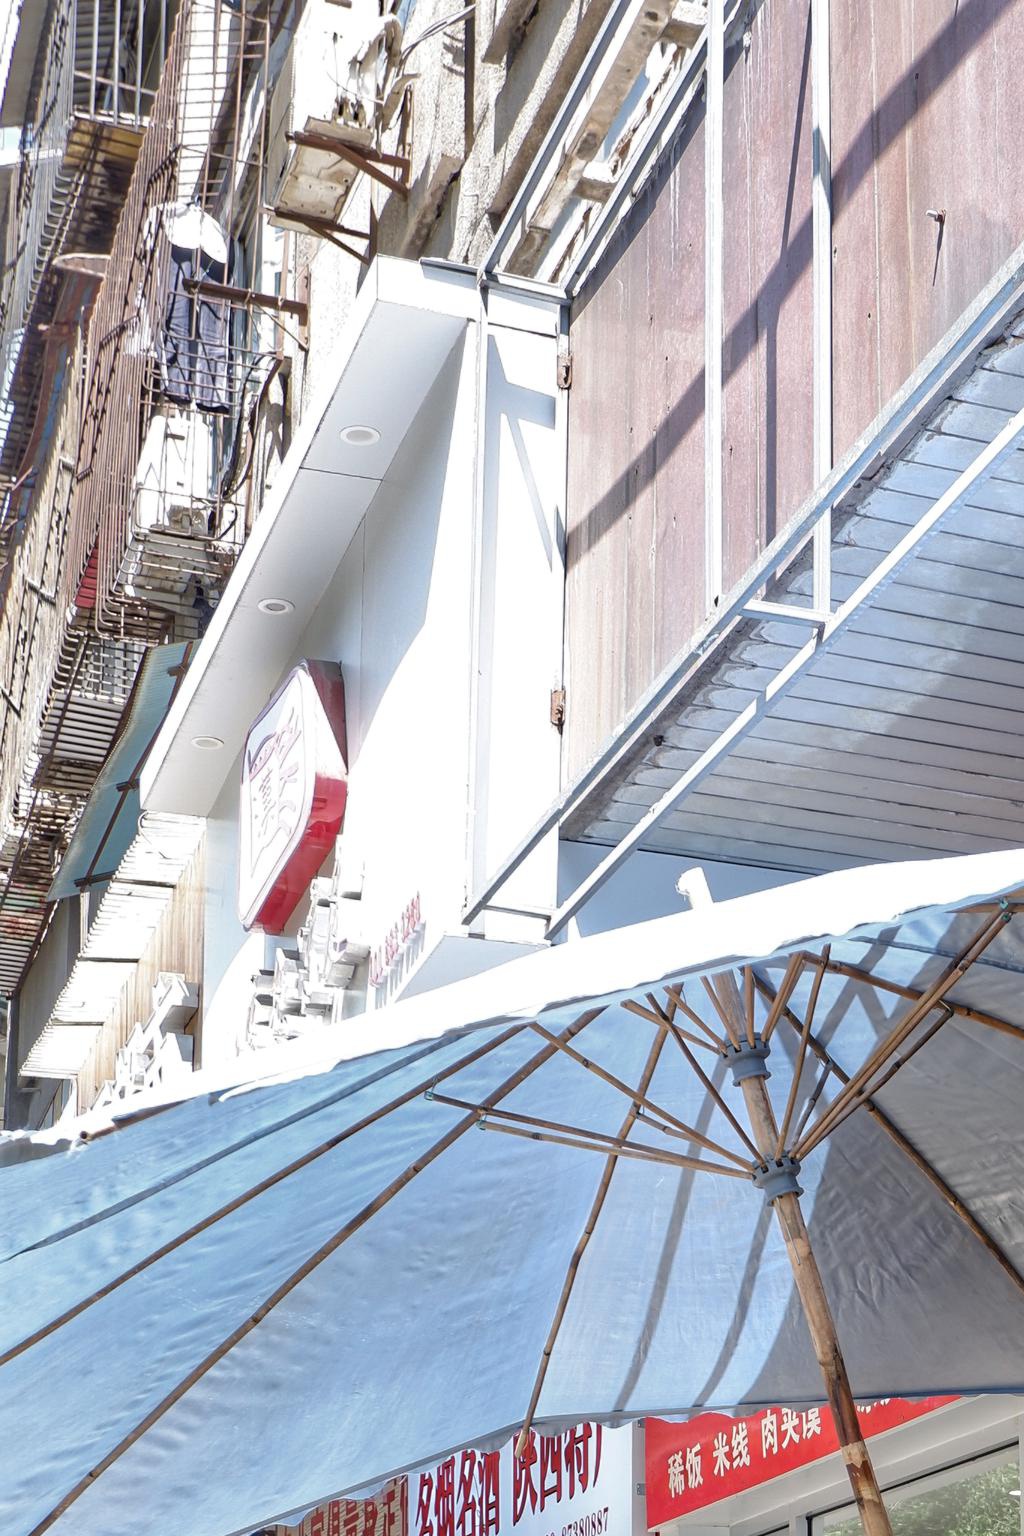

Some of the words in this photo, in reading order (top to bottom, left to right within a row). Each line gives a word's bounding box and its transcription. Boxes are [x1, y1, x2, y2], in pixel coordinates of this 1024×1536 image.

[512, 1422, 602, 1527] 陕西特
[667, 1443, 703, 1498] 稀饭
[712, 1421, 750, 1477] 米线
